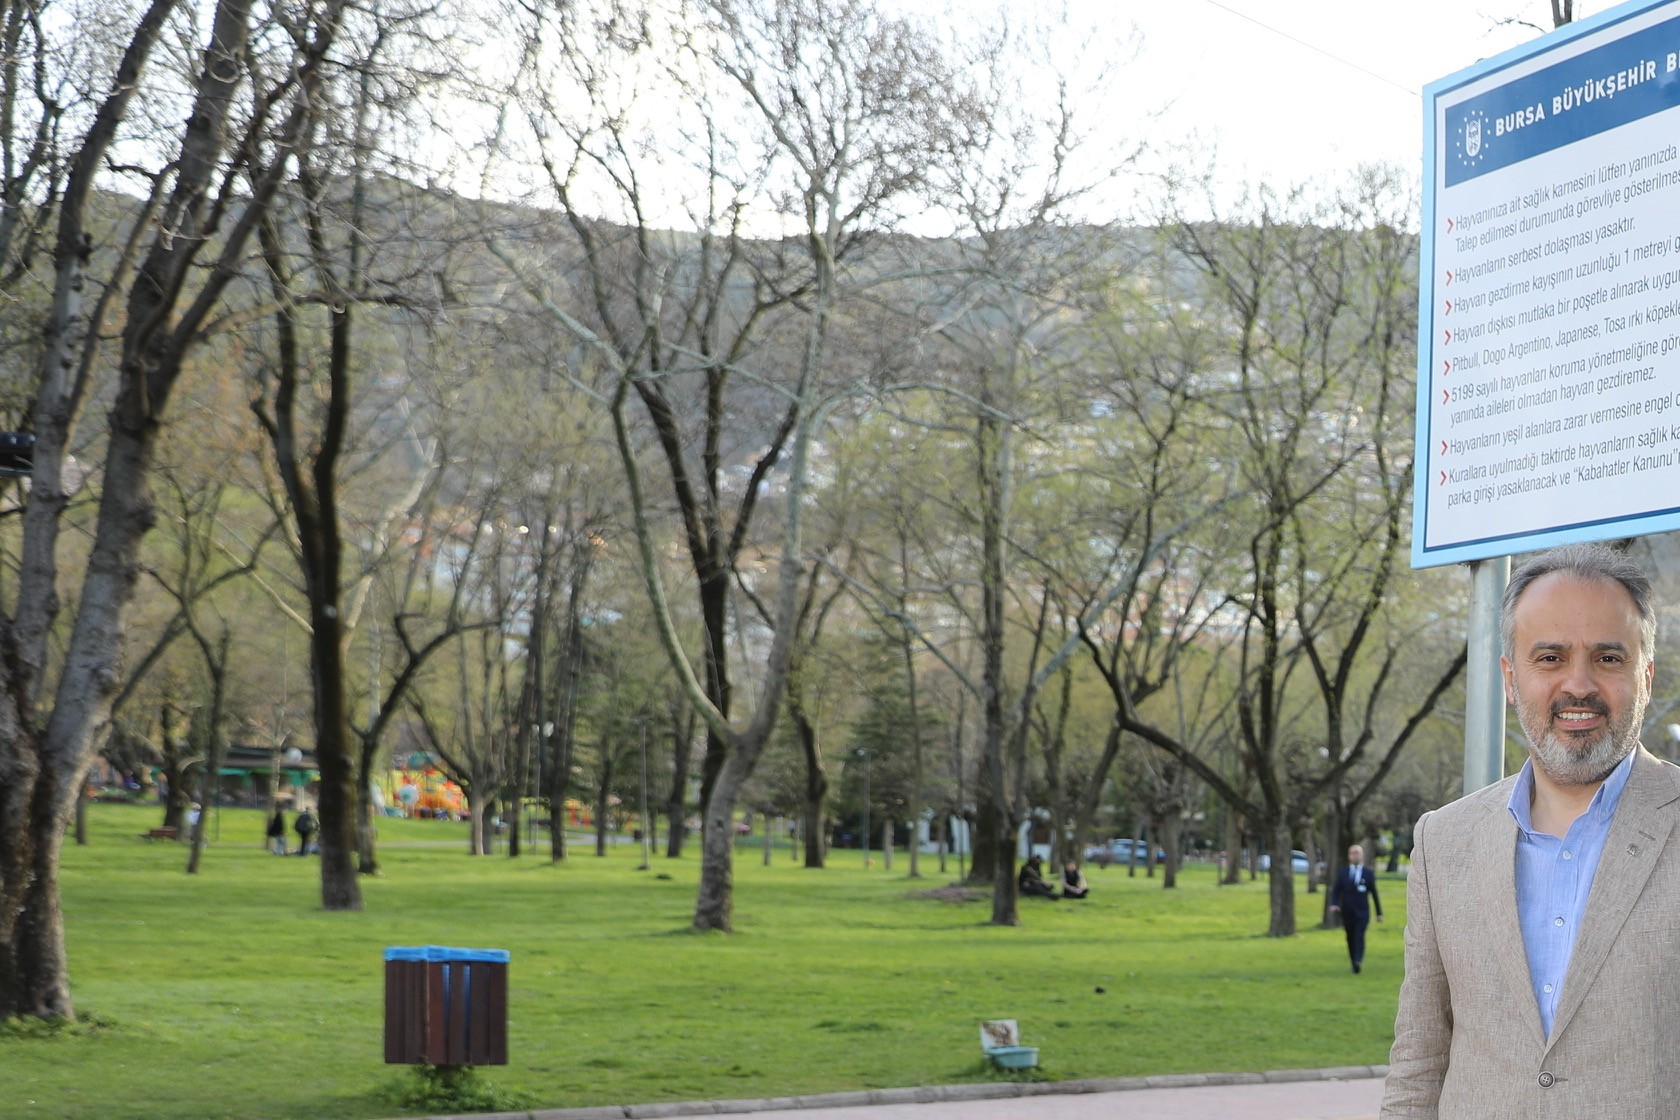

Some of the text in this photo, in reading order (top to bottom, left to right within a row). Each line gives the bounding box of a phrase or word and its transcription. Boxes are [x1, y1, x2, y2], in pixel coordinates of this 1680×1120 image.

[1495, 102, 1546, 137] BURSA
[1552, 59, 1657, 116] BÜYÜKŞEHİR
[1509, 195, 1521, 214] ait
[1522, 185, 1550, 209] sağlık
[1598, 162, 1626, 184] lütfen
[1628, 143, 1677, 178] yanınızda
[1454, 216, 1636, 284] Hayvanların serbest dolaşması yasaktır.
[1455, 235, 1478, 253] Talep
[1479, 218, 1517, 246] edilmesi
[1518, 201, 1574, 233] durumunda
[1576, 188, 1621, 219] görevliye
[1453, 292, 1486, 314] Hayvan
[1487, 280, 1530, 307] gezdirme
[1532, 267, 1573, 292] kayışının
[1575, 251, 1621, 278] uzunluğu
[1624, 247, 1629, 264] 1
[1633, 234, 1672, 262] metreyi
[1452, 351, 1481, 372] Pitbull,
[1482, 347, 1506, 365] Dogo
[1507, 335, 1553, 360] Argentino,
[1554, 323, 1601, 348] Japanese,
[1603, 316, 1626, 334] Tosa
[1628, 309, 1643, 328] ırkı
[1453, 323, 1486, 344] Hayvan
[1487, 314, 1516, 336] dışkısı
[1518, 302, 1555, 325] mutlaka
[1557, 296, 1571, 315] bir
[1572, 286, 1608, 315] poşetle
[1609, 274, 1650, 301] alınarak
[1450, 366, 1656, 428] yanında aileleri olmadan hayvan gezdiremez.
[1451, 382, 1474, 403] 5199
[1475, 377, 1498, 398] sayılı
[1500, 367, 1547, 392] hayvanları
[1548, 358, 1586, 380] koruma
[1587, 339, 1659, 374] yönetmeliğine
[1448, 464, 1487, 484] Kurallara
[1488, 451, 1539, 479] uyulmadığı
[1540, 444, 1576, 466] taktirde
[1578, 435, 1635, 461] hayvanların
[1635, 425, 1669, 449] sağlık
[1449, 432, 1501, 456] Hayvanların
[1502, 423, 1524, 447] yeşil
[1524, 418, 1562, 439] alanlara
[1562, 413, 1588, 431] zarar
[1589, 400, 1642, 424] vermesine
[1644, 391, 1673, 415] engel
[1447, 488, 1472, 509] parka
[1473, 482, 1495, 505] girişi
[1496, 470, 1558, 501] yasaklanacak
[1558, 471, 1571, 486] ve
